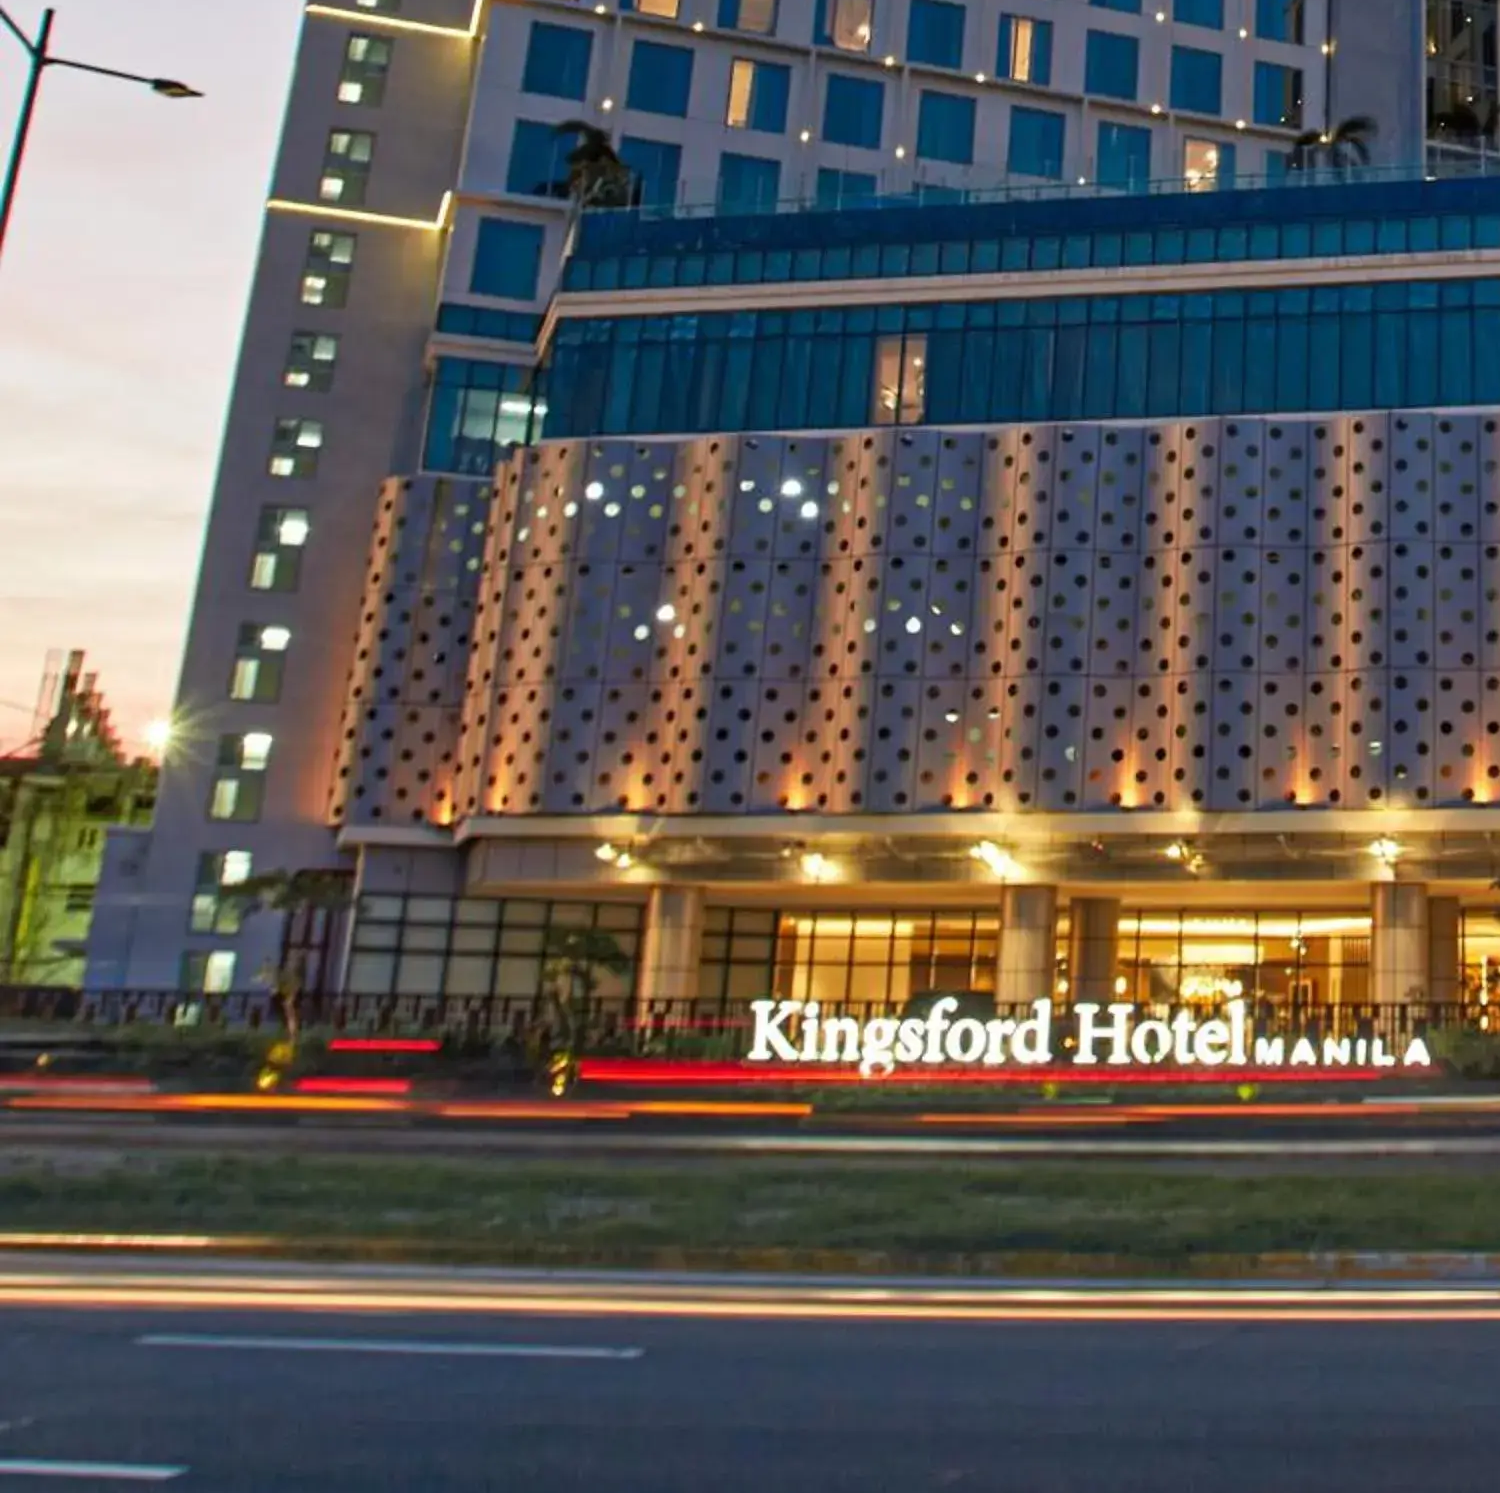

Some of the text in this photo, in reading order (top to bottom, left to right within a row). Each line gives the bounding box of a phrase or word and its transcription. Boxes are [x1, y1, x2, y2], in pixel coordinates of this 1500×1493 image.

[748, 997, 1430, 1078] Kingsford Hotel MANILA
